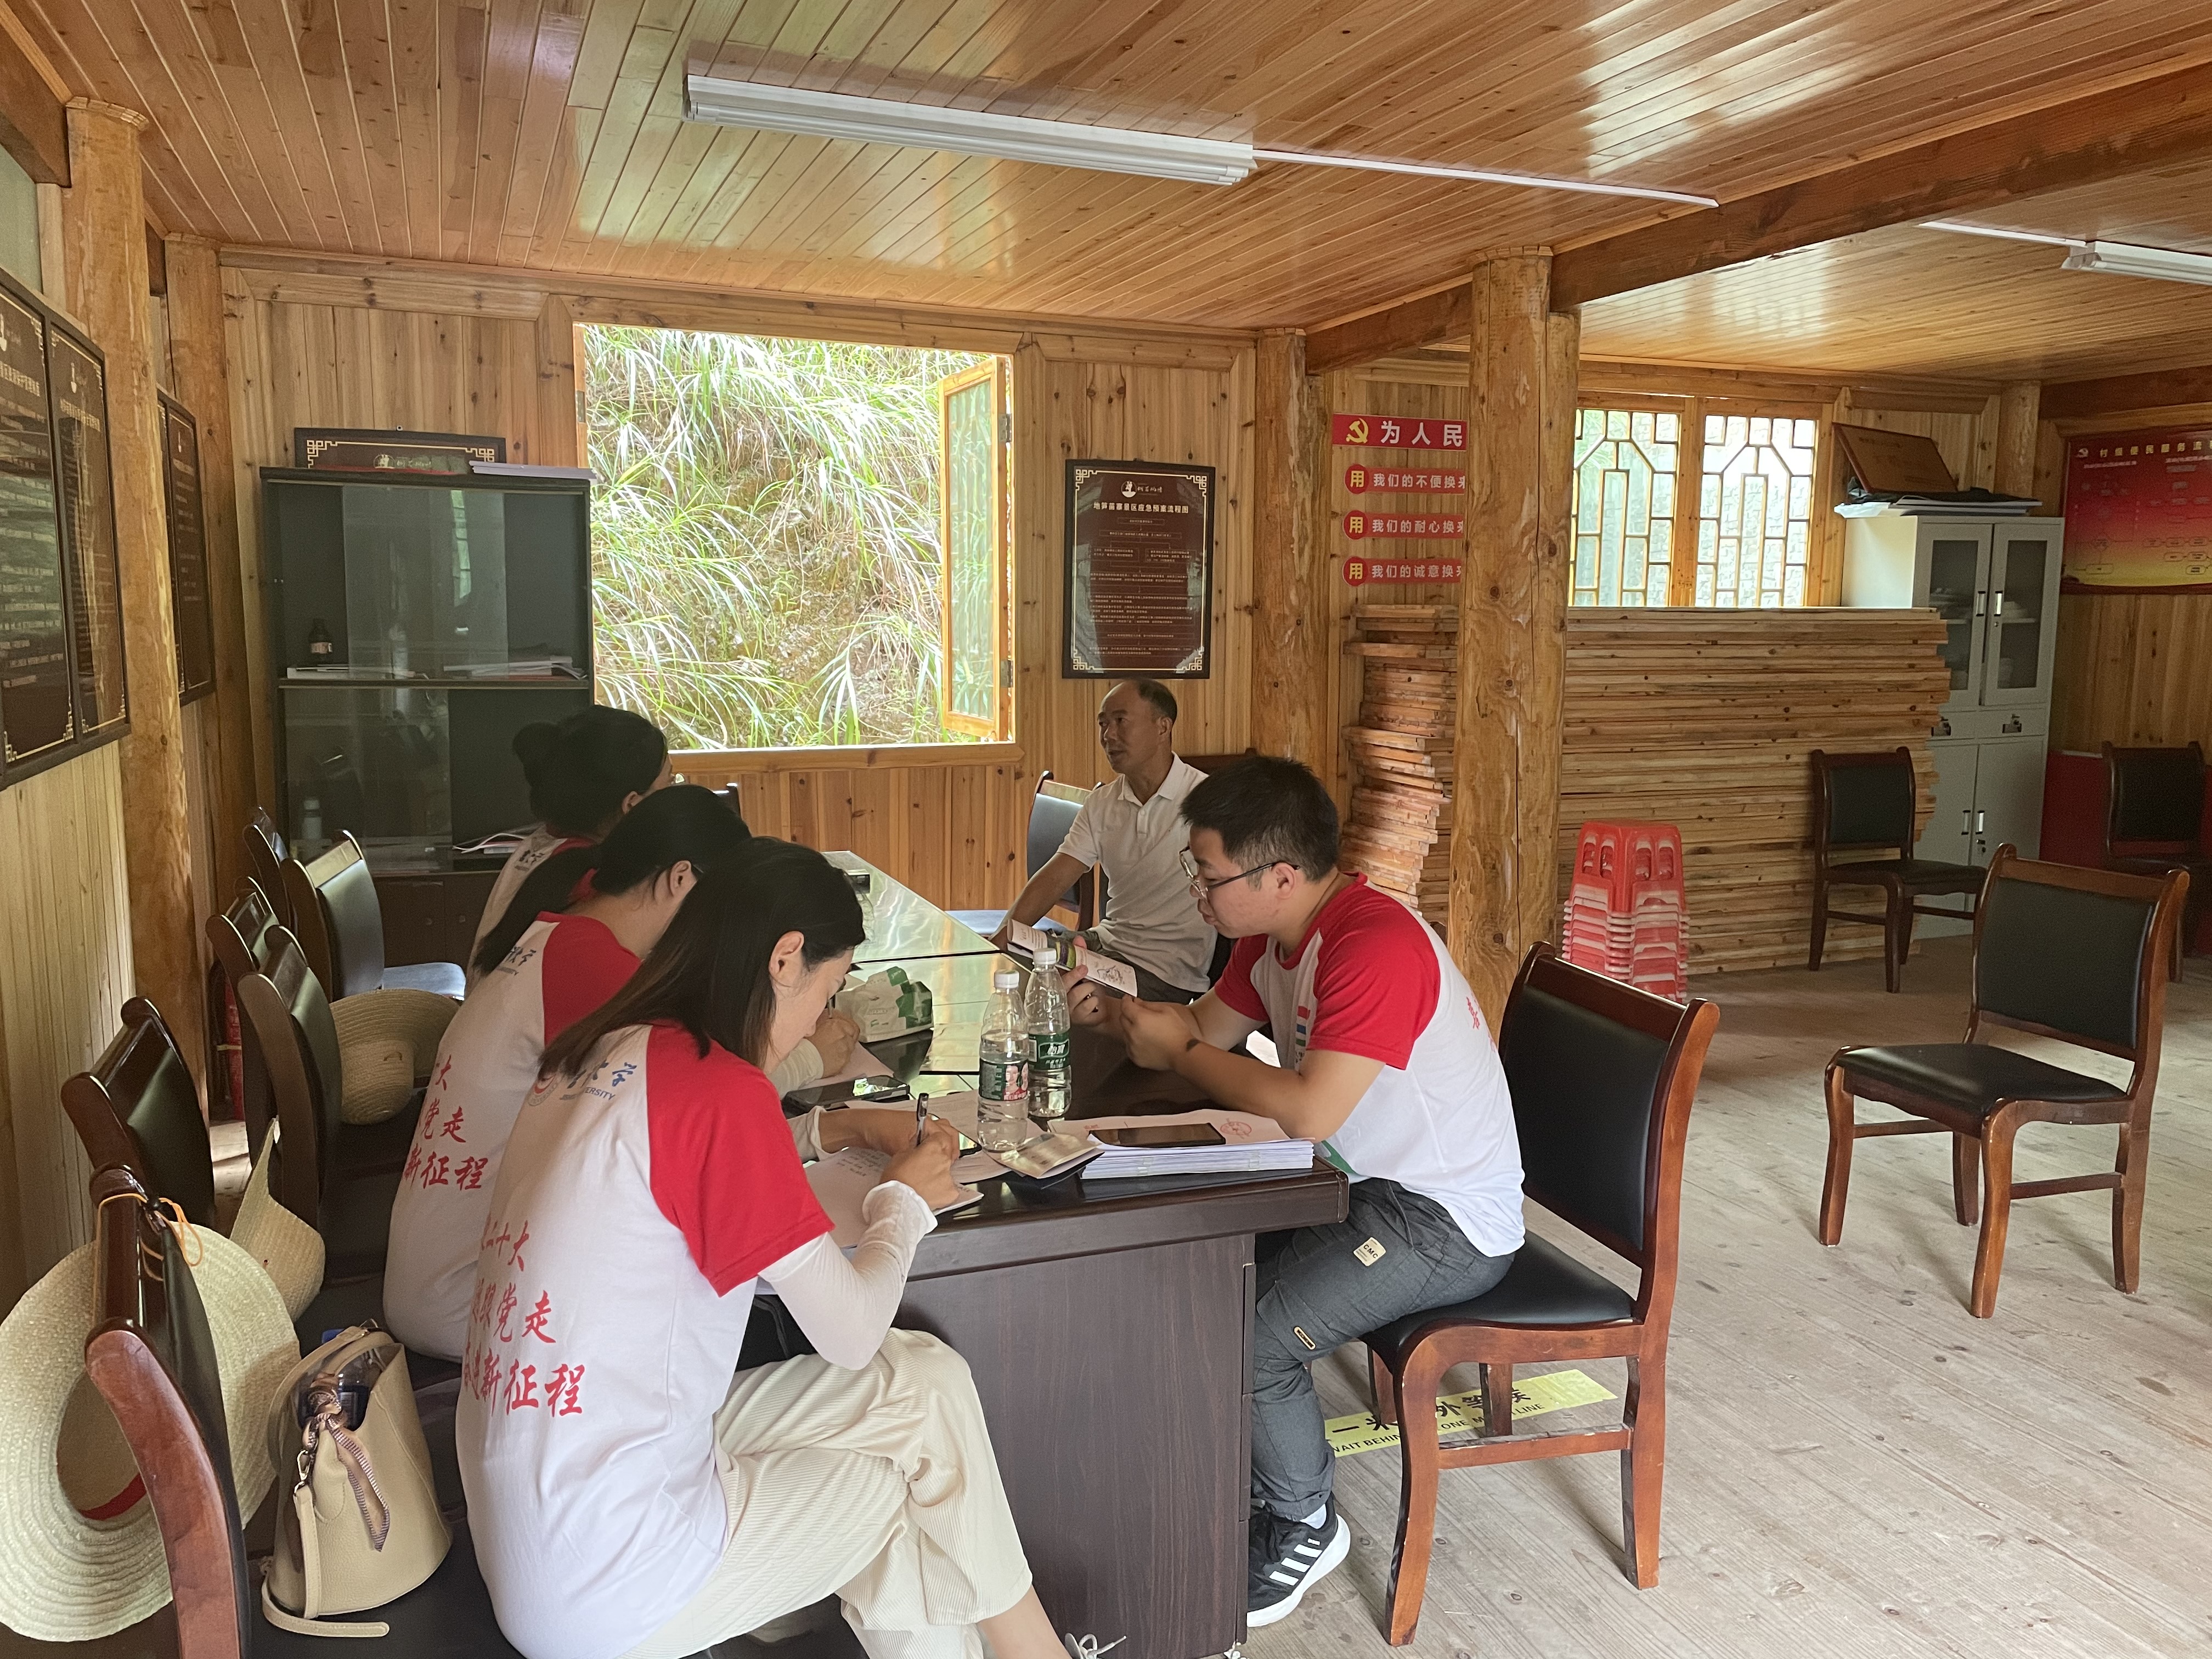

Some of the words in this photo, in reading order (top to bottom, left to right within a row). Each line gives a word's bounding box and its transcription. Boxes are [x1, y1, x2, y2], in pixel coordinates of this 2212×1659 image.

[1380, 420, 1463, 447] 为人民
[585, 1086, 616, 1101] ERSITY
[1363, 1244, 1378, 1259] CMC
[1363, 1434, 1400, 1446] BEHIN
[1441, 1420, 1469, 1430] ONE
[1516, 1403, 1545, 1414] LINE
